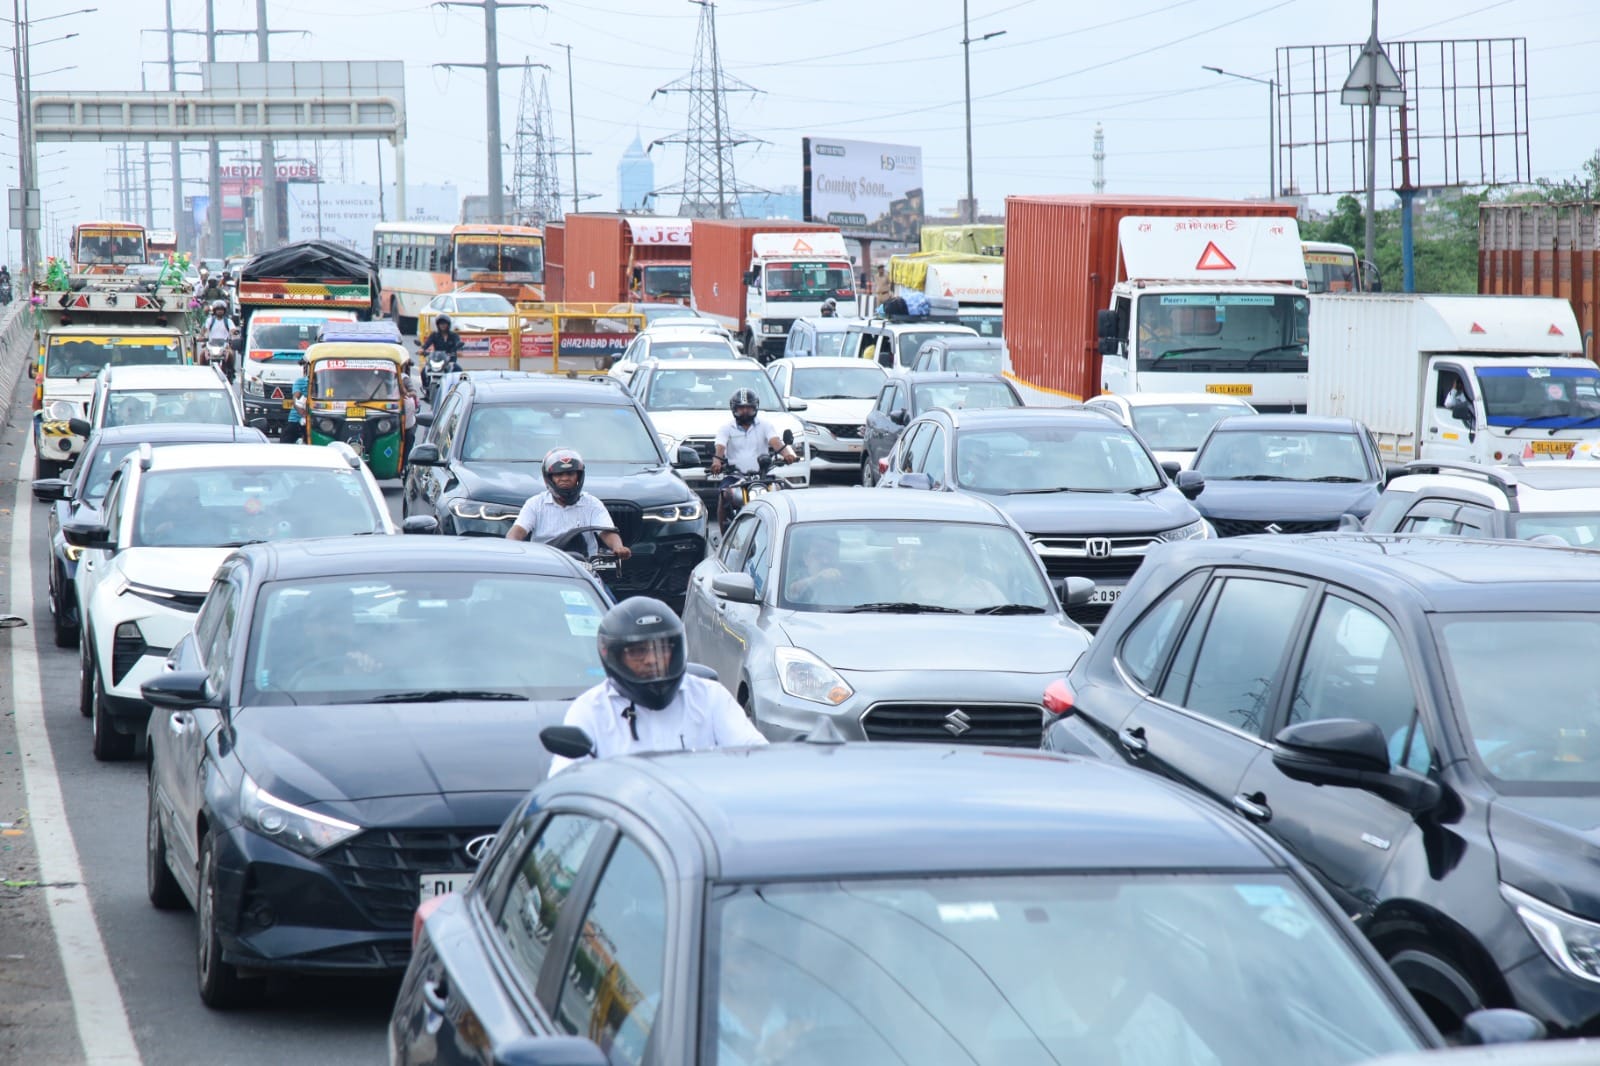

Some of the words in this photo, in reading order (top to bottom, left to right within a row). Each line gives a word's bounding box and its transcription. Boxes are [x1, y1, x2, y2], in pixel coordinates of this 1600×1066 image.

[220, 166, 262, 177] MEDIA
[274, 166, 317, 177] OUSE
[816, 173, 856, 201] Coming
[561, 338, 607, 349] GHAZIABAD
[609, 338, 632, 349] POLI
